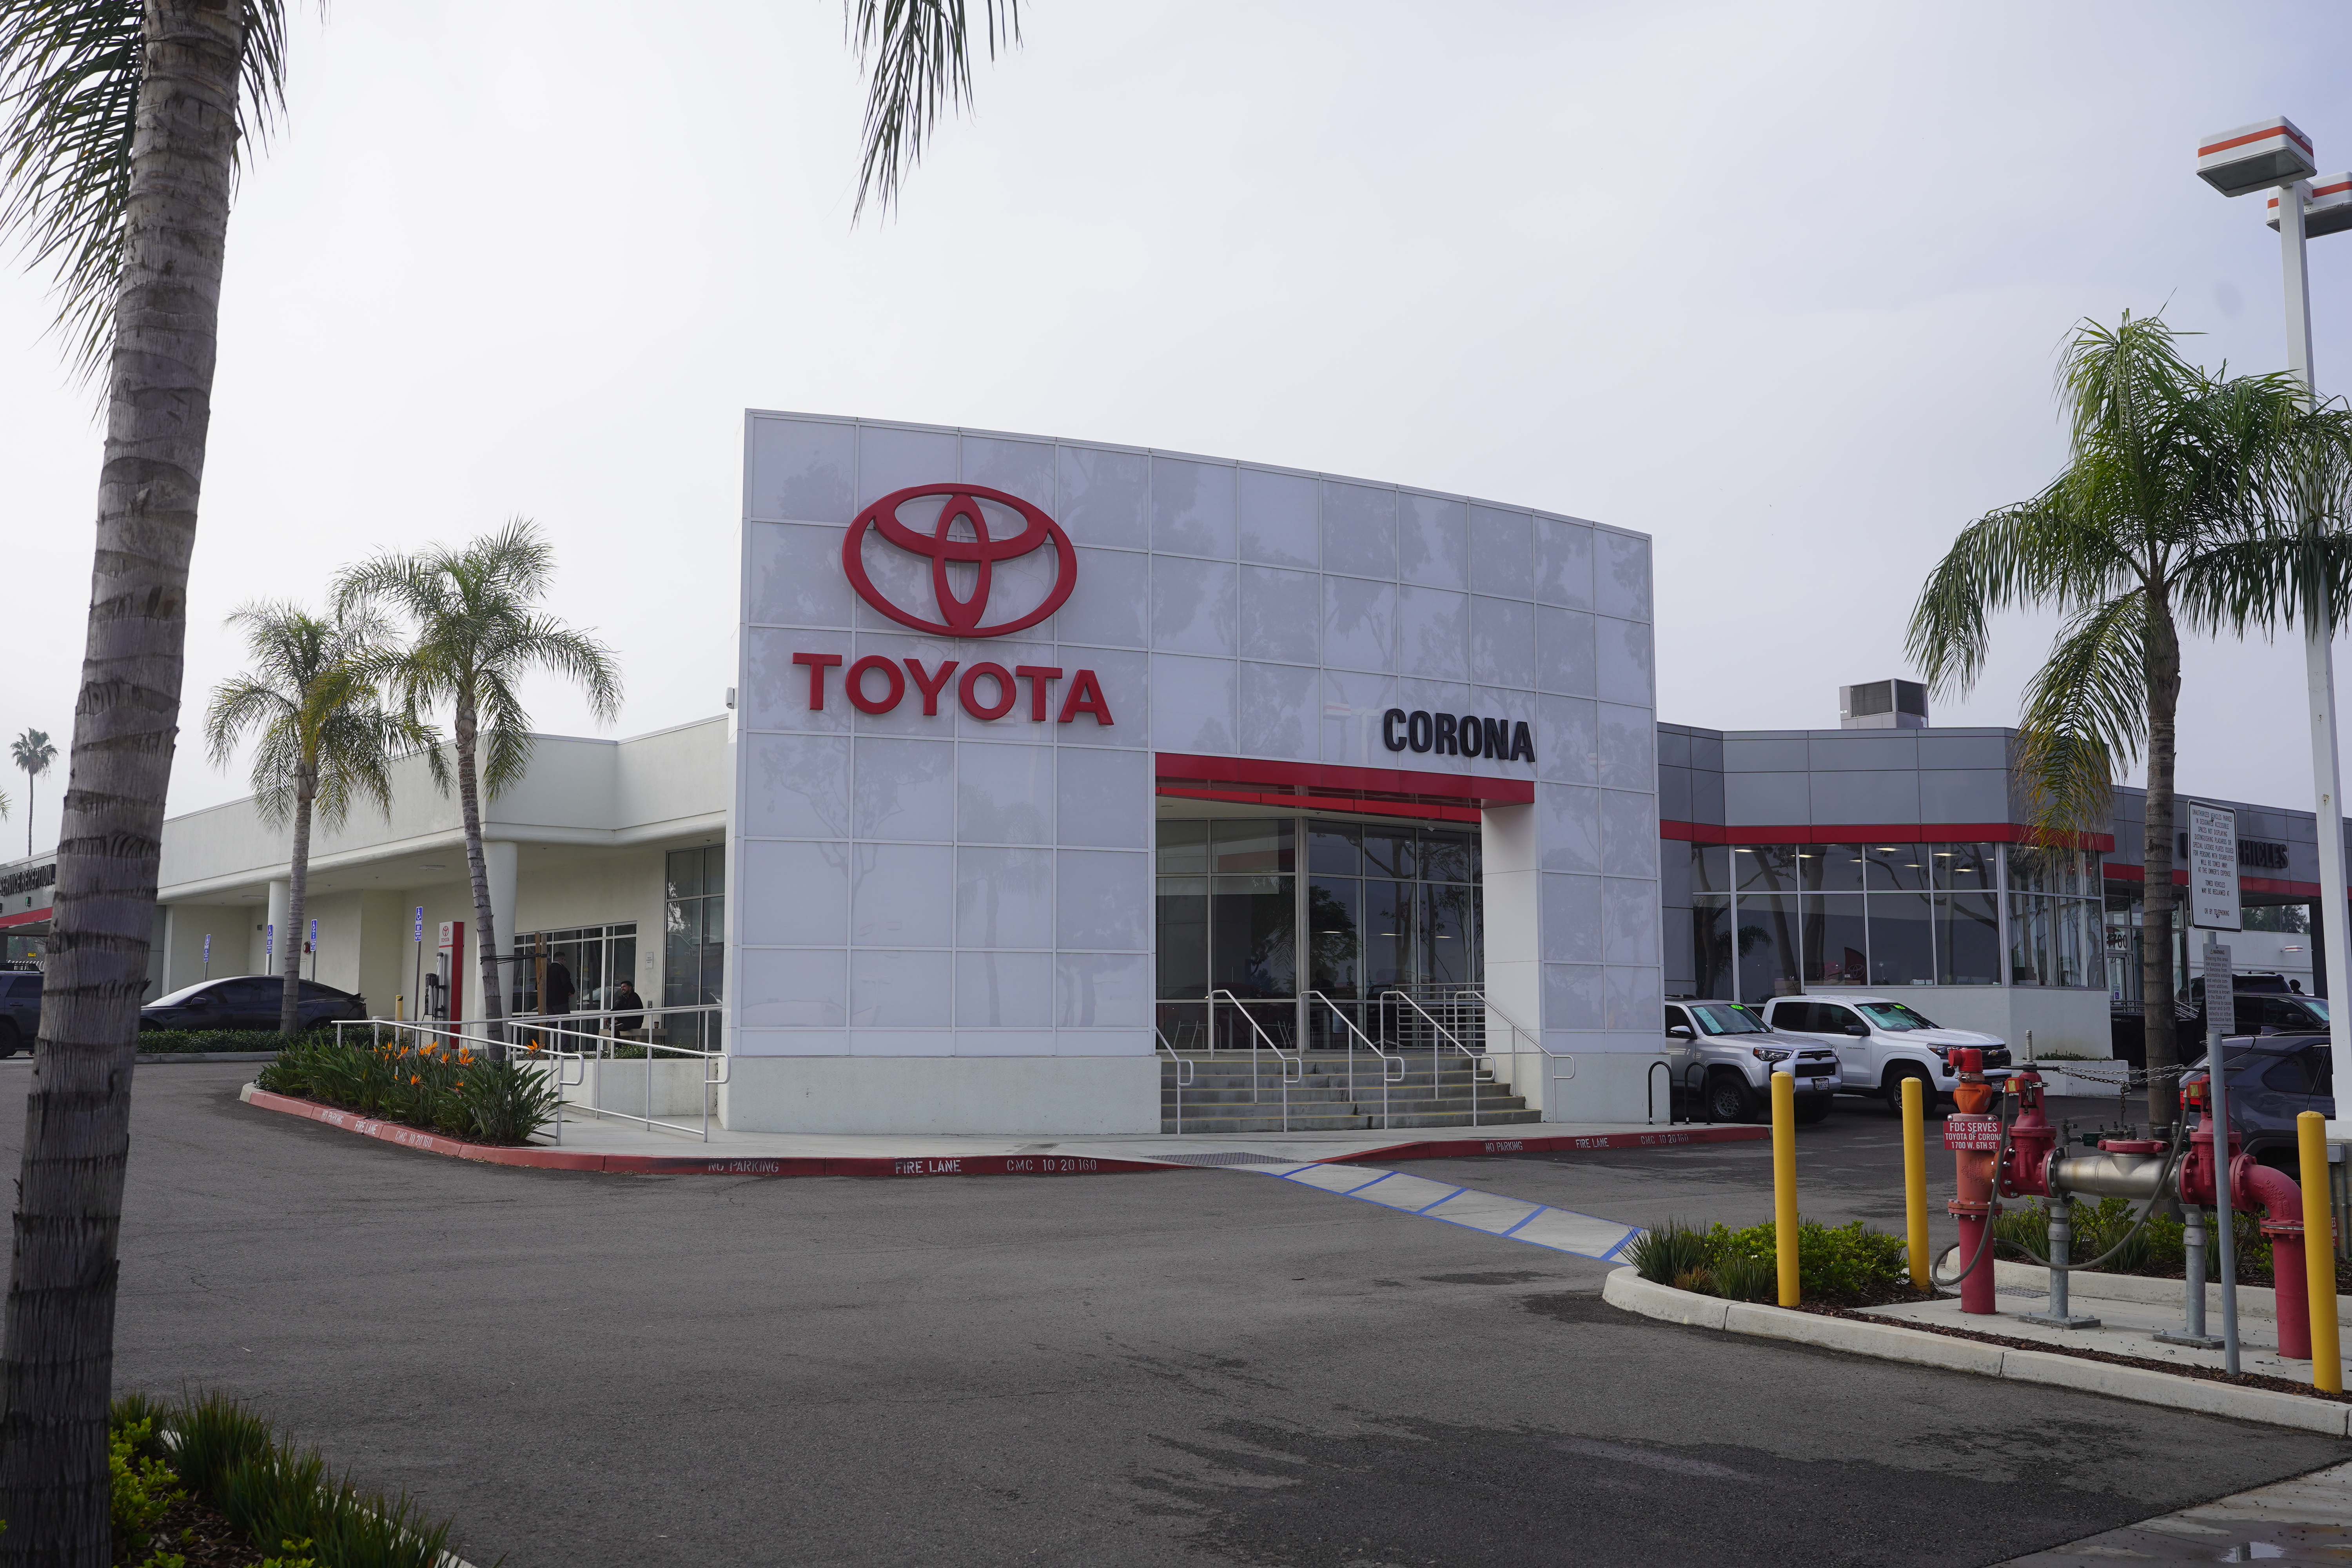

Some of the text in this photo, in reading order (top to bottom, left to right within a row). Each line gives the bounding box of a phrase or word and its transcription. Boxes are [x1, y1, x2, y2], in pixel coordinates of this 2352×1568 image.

[793, 652, 1114, 726] TOYOTA
[1384, 708, 1535, 762] CORONA
[2195, 834, 2213, 842] DISTINGUISHING
[2238, 839, 2288, 868] EHICLES
[0, 864, 54, 896] SERVICE RECEPTION
[2107, 934, 2127, 948] 1700
[321, 1110, 328, 1120] NO
[328, 1112, 344, 1125] PARKING
[354, 1120, 378, 1135] FIRE LANE
[1950, 1122, 1997, 1132] FDC SERVES
[395, 1131, 407, 1142] CMC
[408, 1134, 416, 1144] 10
[416, 1135, 423, 1145] 20
[1575, 1138, 1609, 1148] FIRE LANE
[1641, 1136, 1655, 1144] CMC
[1659, 1135, 1666, 1143] 10
[1668, 1134, 1677, 1143] 20
[1485, 1142, 1523, 1152] NO PARKING
[709, 1160, 779, 1172] NO PARKING
[895, 1160, 961, 1174] FIRE LANE
[1007, 1159, 1096, 1171] CMC 10 20 160
[2266, 1180, 2286, 1199] UNION
